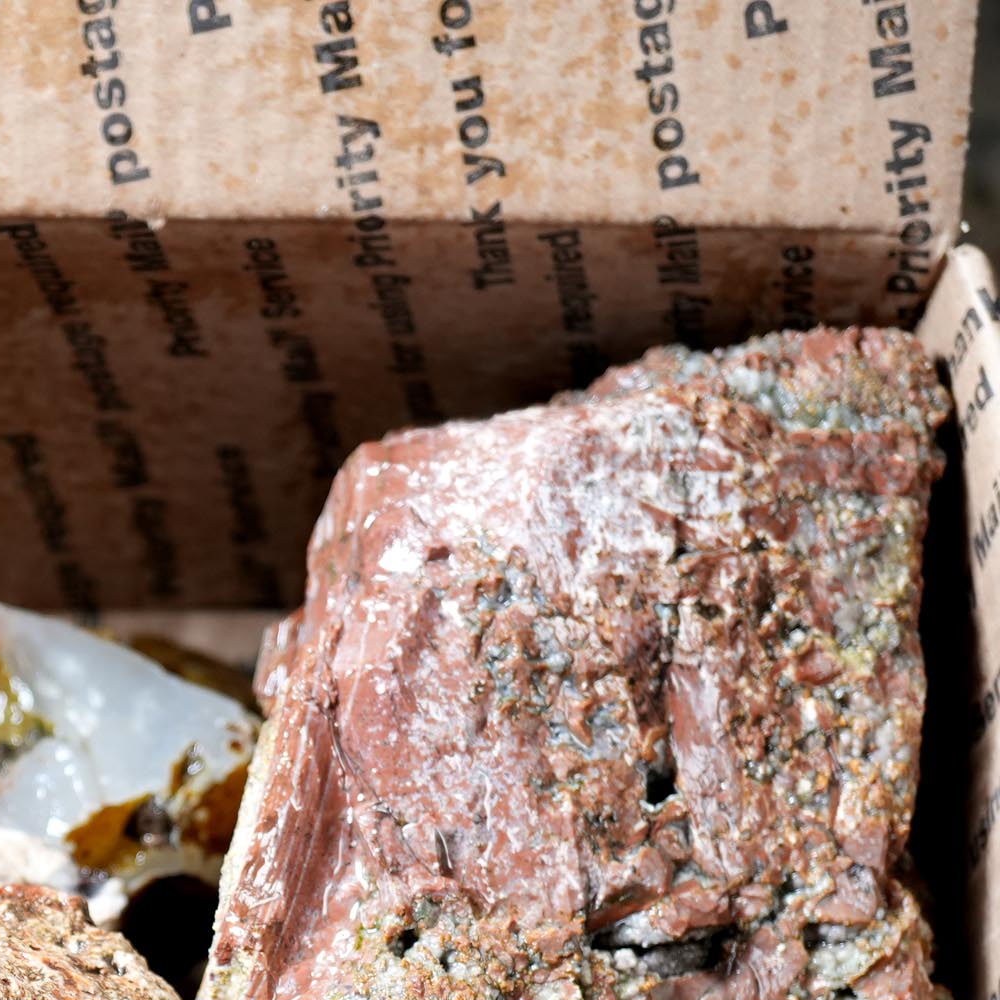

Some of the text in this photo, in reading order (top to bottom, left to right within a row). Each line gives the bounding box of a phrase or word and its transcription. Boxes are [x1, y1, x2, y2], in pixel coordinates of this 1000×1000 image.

[313, 0, 364, 95] Ma
[432, 0, 517, 291] Thank you fo
[886, 118, 933, 299] Priority
[140, 277, 212, 360] Priority
[241, 237, 304, 319] Service
[537, 228, 600, 336] required
[61, 320, 135, 413] postage
